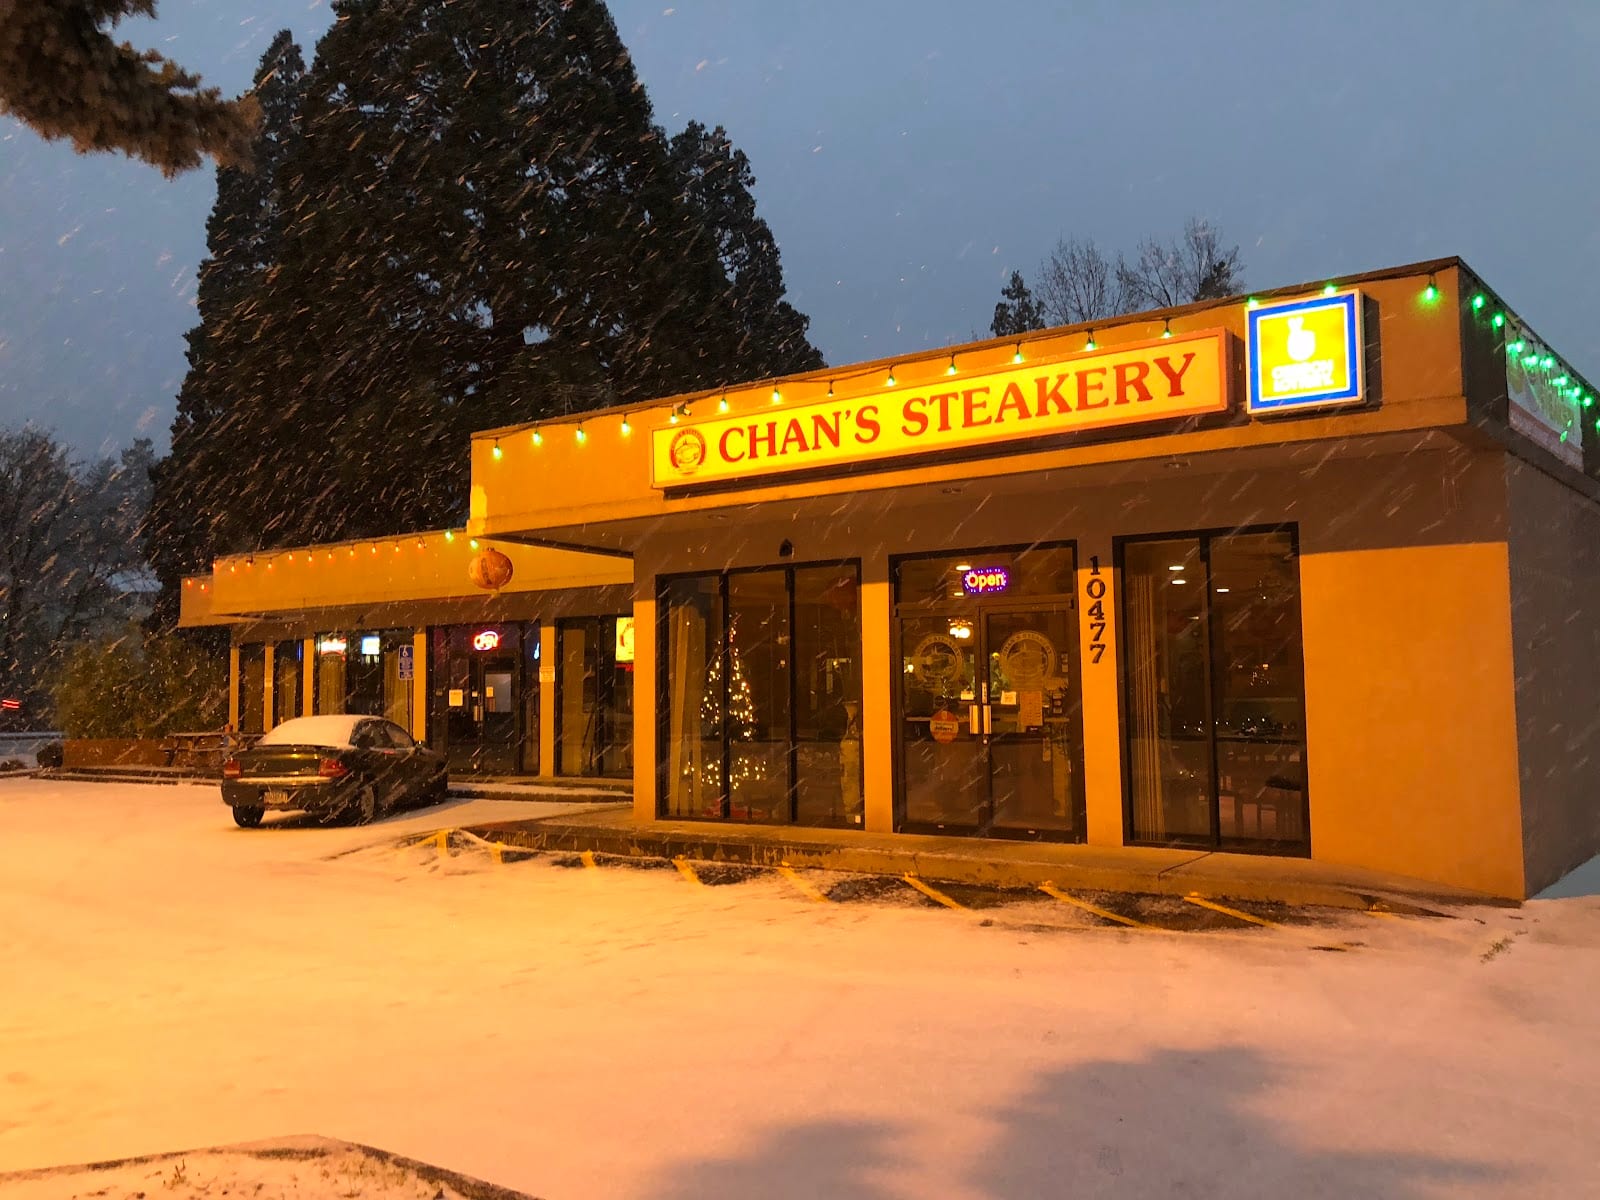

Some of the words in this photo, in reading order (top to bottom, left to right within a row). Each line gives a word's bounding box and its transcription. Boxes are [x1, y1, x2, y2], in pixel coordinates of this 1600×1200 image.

[719, 406, 879, 462] CHAN'S
[903, 353, 1194, 436] STEAKERY
[968, 571, 1004, 590] Open
[1086, 556, 1106, 664] 10477
[474, 634, 498, 649] OPEN
